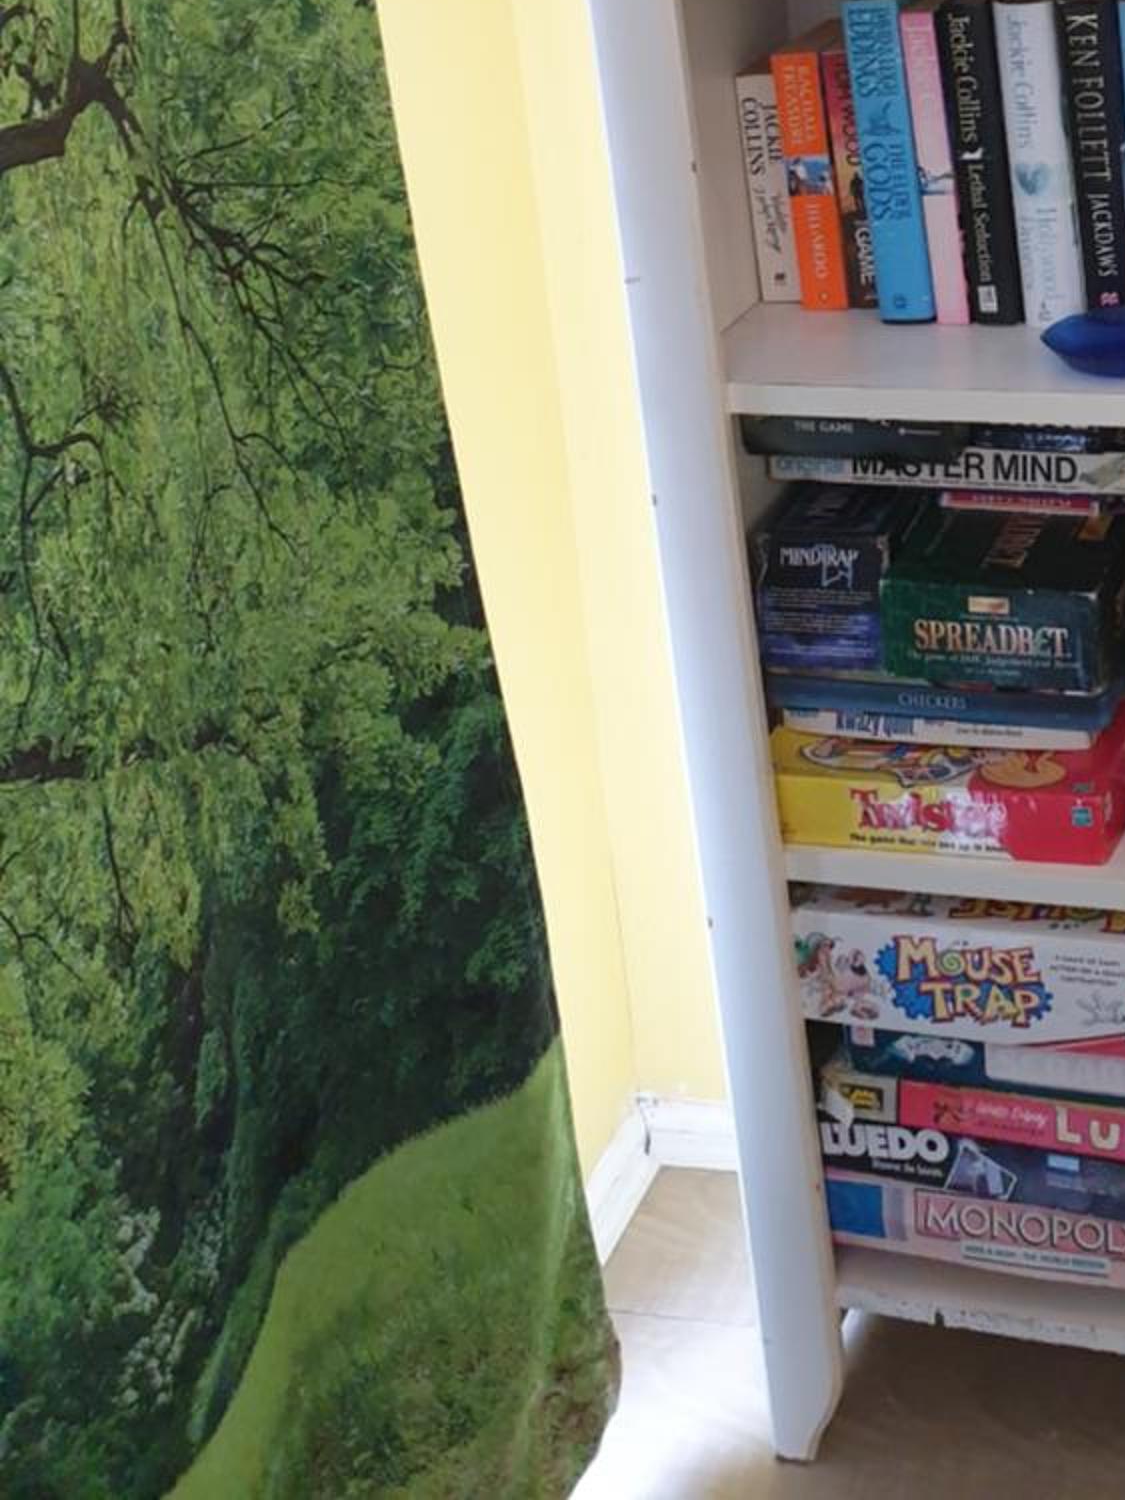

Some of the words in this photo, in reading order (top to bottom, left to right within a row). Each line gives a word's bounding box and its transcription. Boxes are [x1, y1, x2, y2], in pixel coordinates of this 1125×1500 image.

[846, 6, 880, 99] EDDINGS
[946, 11, 974, 73] Jackie
[1065, 12, 1103, 69] KEN
[742, 97, 766, 176] COLLINS
[763, 103, 784, 162] JACKIE
[957, 75, 984, 145] Collins
[1072, 75, 1113, 184] FOLLETT
[865, 141, 896, 222] GODS
[968, 163, 988, 209] Lethal
[853, 228, 873, 288] GAME
[972, 209, 994, 284] Seduction
[1087, 192, 1120, 279] JACKDAWS
[851, 452, 986, 480] MASTER
[992, 453, 1078, 484] MIND
[893, 933, 1042, 985] MOUSE
[919, 978, 1044, 1028] TRAP
